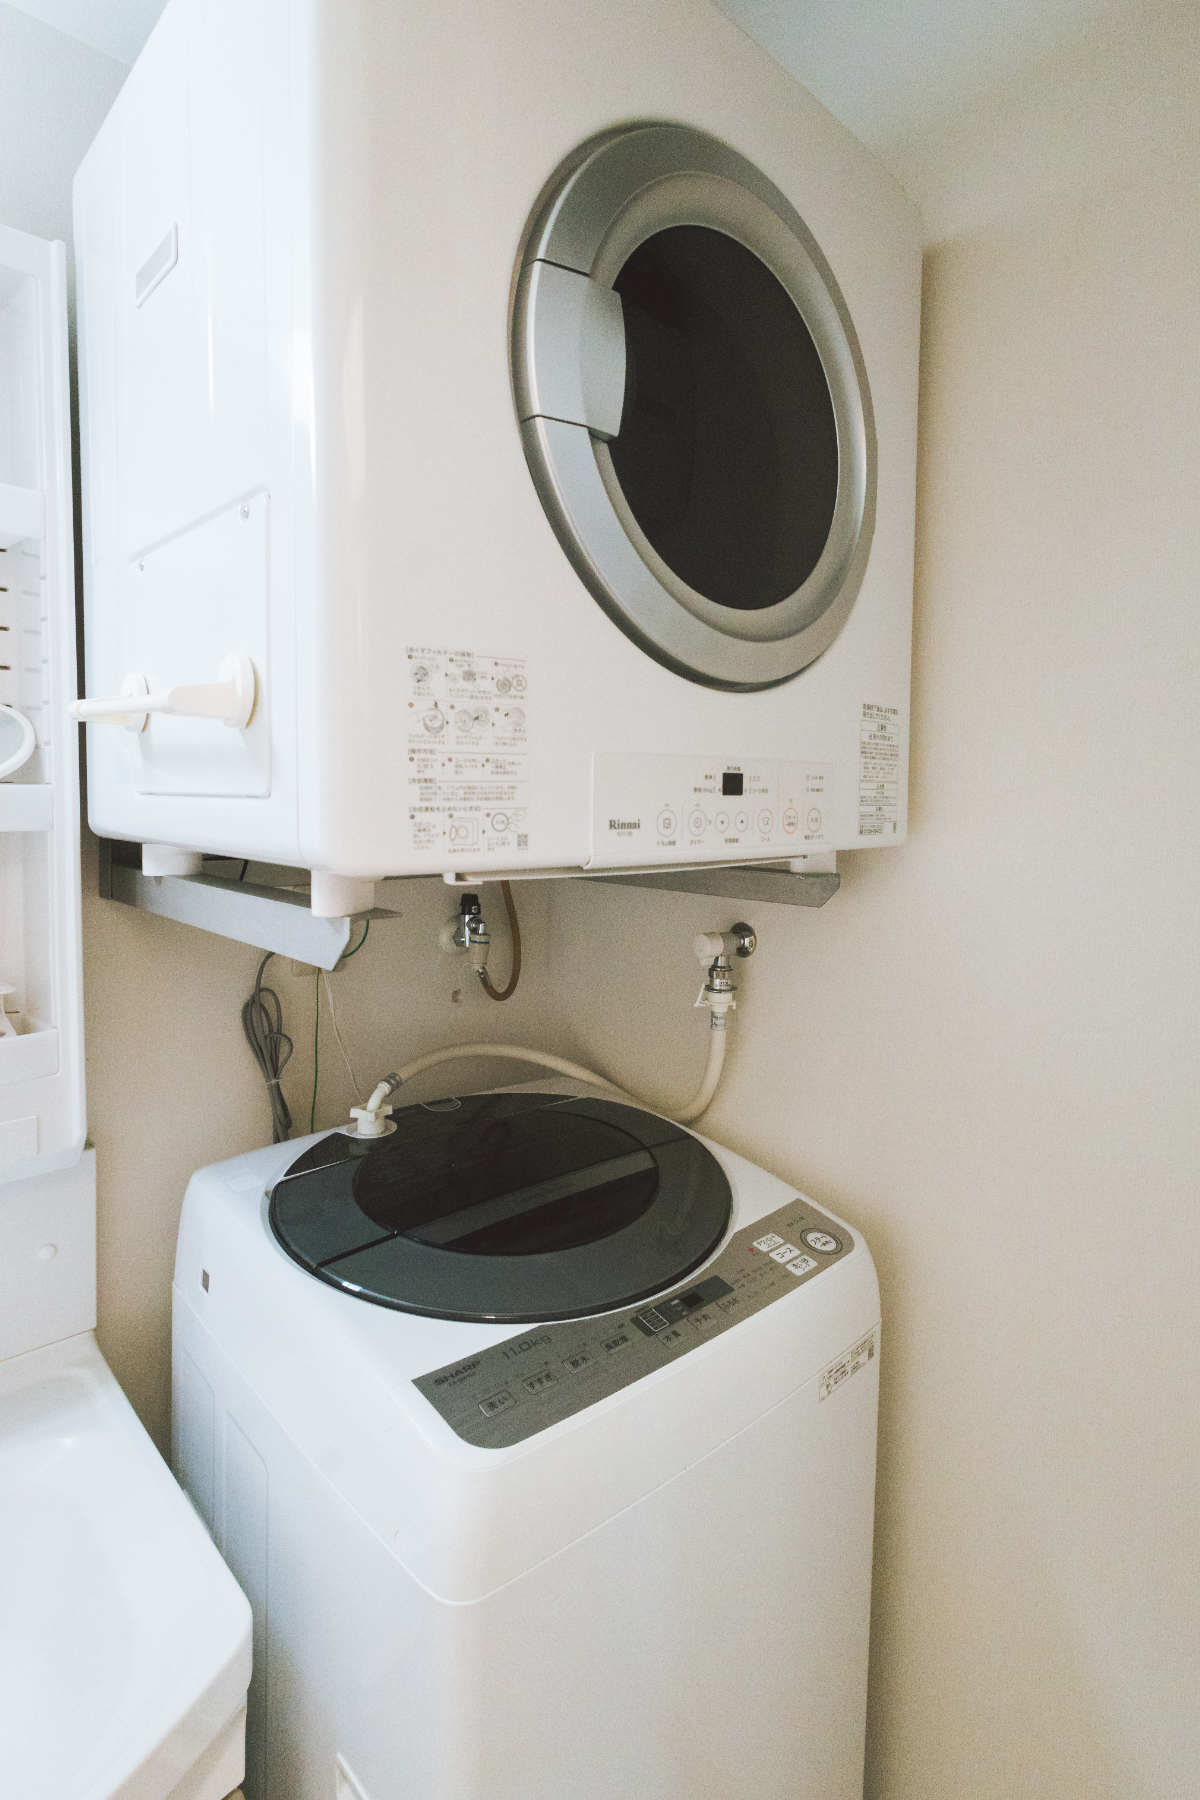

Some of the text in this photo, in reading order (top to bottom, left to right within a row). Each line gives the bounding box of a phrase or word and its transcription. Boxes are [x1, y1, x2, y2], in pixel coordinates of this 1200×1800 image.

[608, 818, 641, 830] Rinnai
[810, 1234, 828, 1246] スタート
[776, 1247, 795, 1260] コース
[501, 1334, 552, 1360] 11.0kg
[434, 1360, 481, 1386] SHARP
[528, 1372, 552, 1390] すすぎ
[486, 1396, 508, 1412] 洗い
